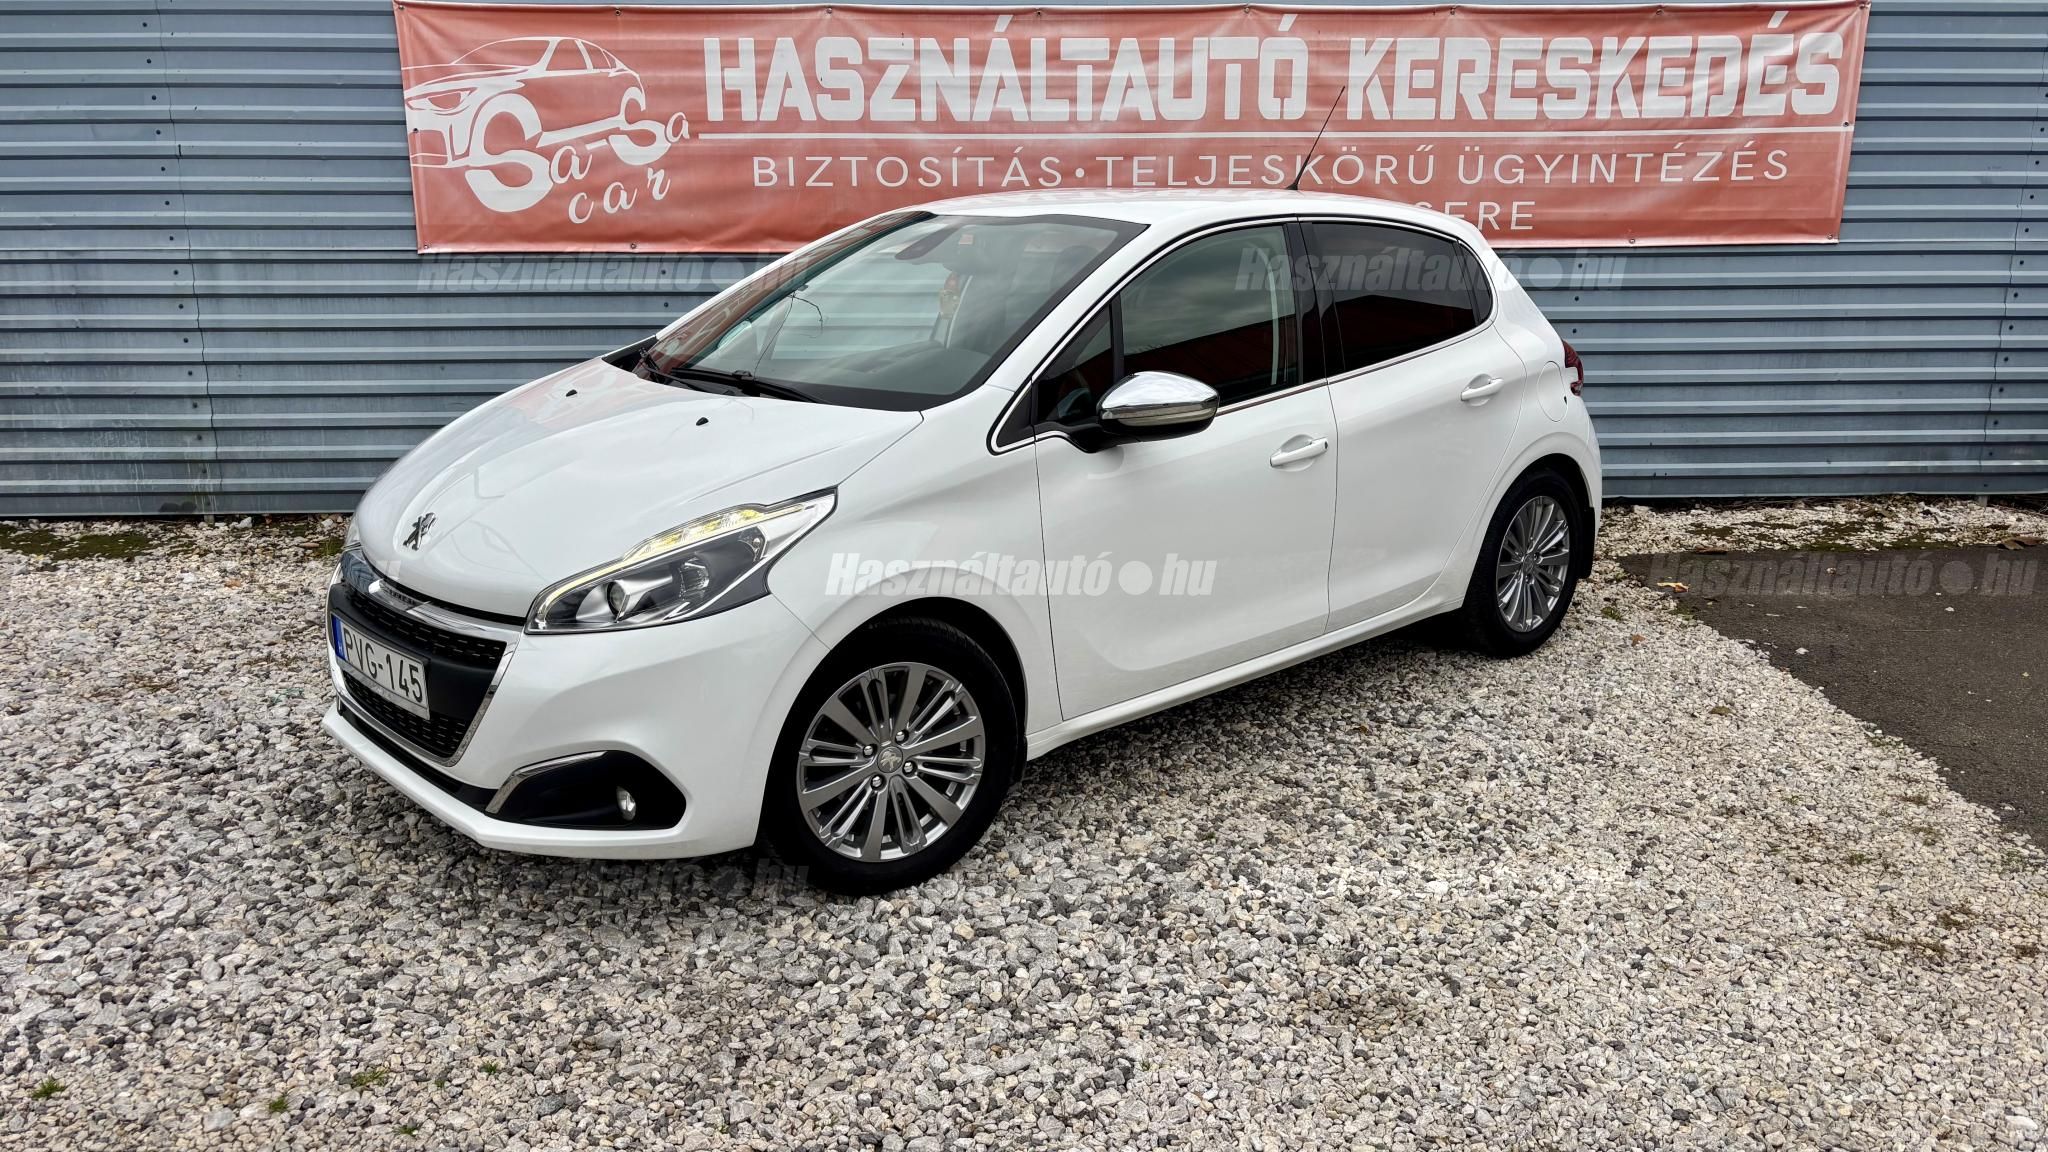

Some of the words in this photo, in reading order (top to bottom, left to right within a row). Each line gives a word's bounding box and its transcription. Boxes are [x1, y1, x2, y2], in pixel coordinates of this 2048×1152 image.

[703, 15, 1309, 122] HASZNÁLTAUTÓ
[1344, 11, 1844, 121] KERESKEDÉS
[568, 166, 672, 225] car
[752, 146, 1063, 188] BIZTOSÍTÁS
[1095, 144, 1436, 187] TELJESKÖRŰ
[1457, 140, 1789, 185] ÜGYINTÉZÉS
[343, 627, 424, 704] PVG-145
